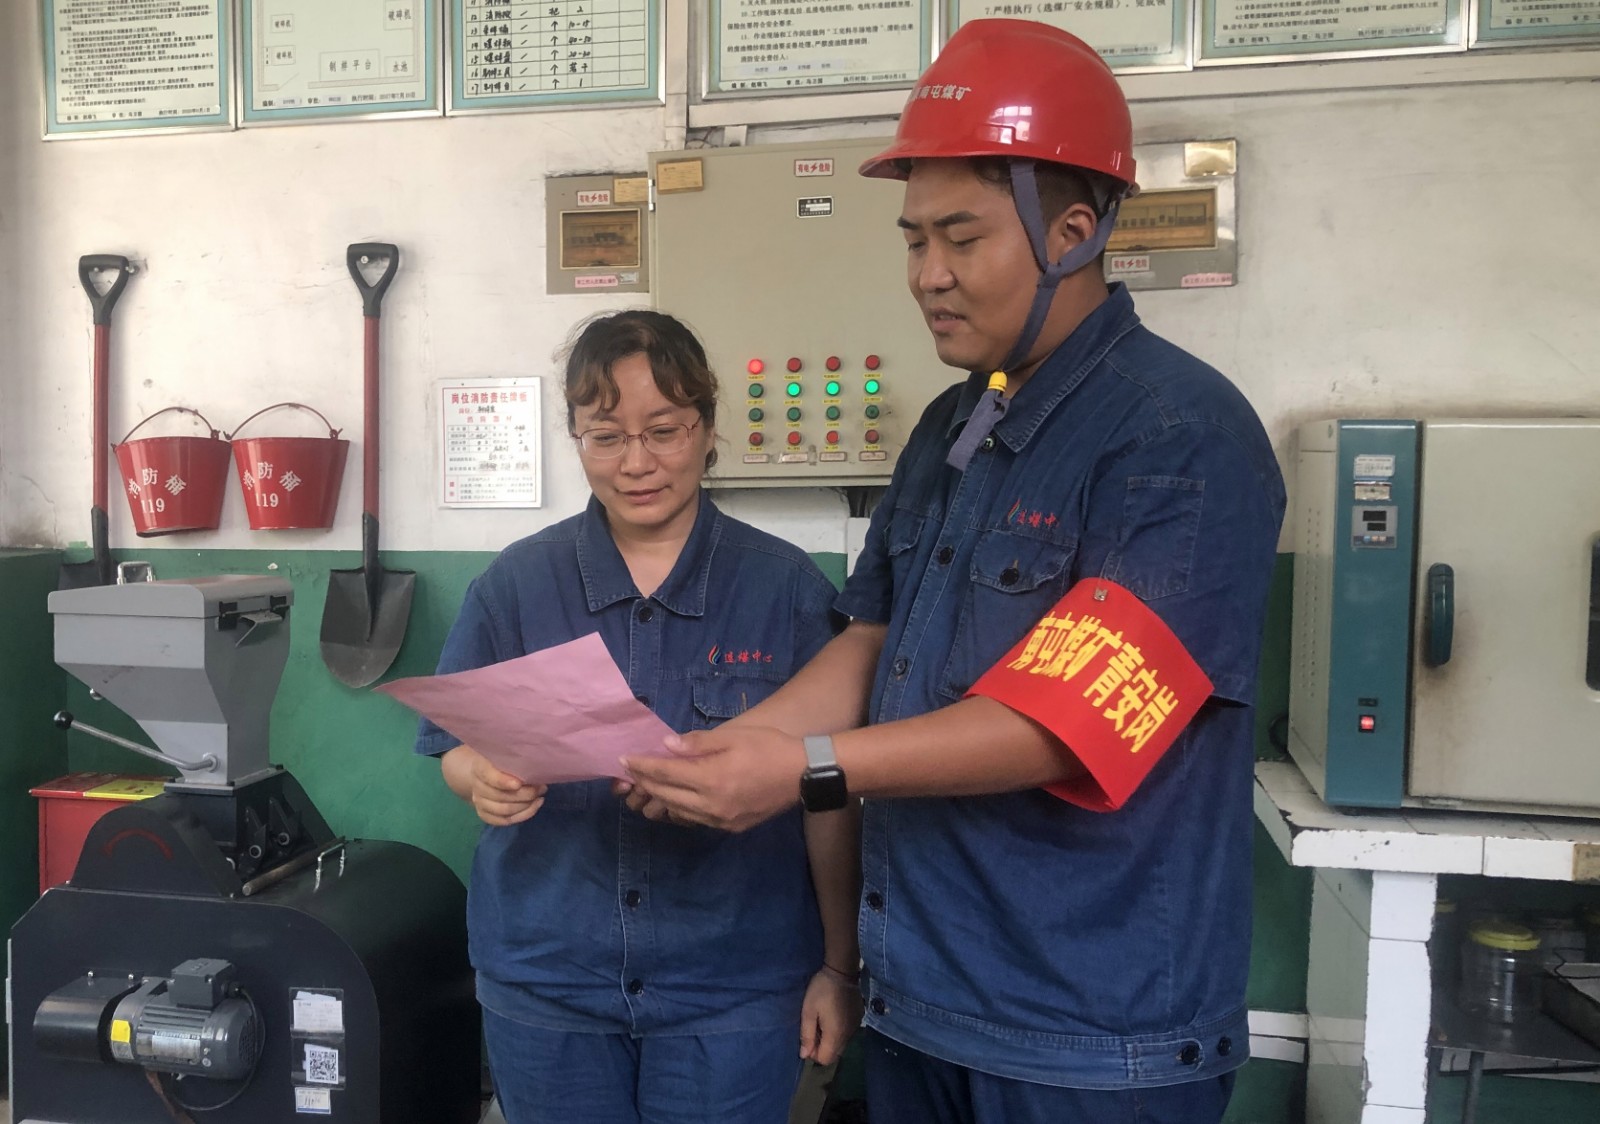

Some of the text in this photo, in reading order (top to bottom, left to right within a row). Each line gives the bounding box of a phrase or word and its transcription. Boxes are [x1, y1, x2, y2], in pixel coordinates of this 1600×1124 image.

[128, 467, 186, 498] 消防桶
[243, 462, 301, 491] 消防桶
[141, 498, 165, 513] 119
[256, 493, 279, 507] 119
[1017, 509, 1059, 528] 选煤中
[1006, 611, 1179, 753] 南屯煤矿青安岗
